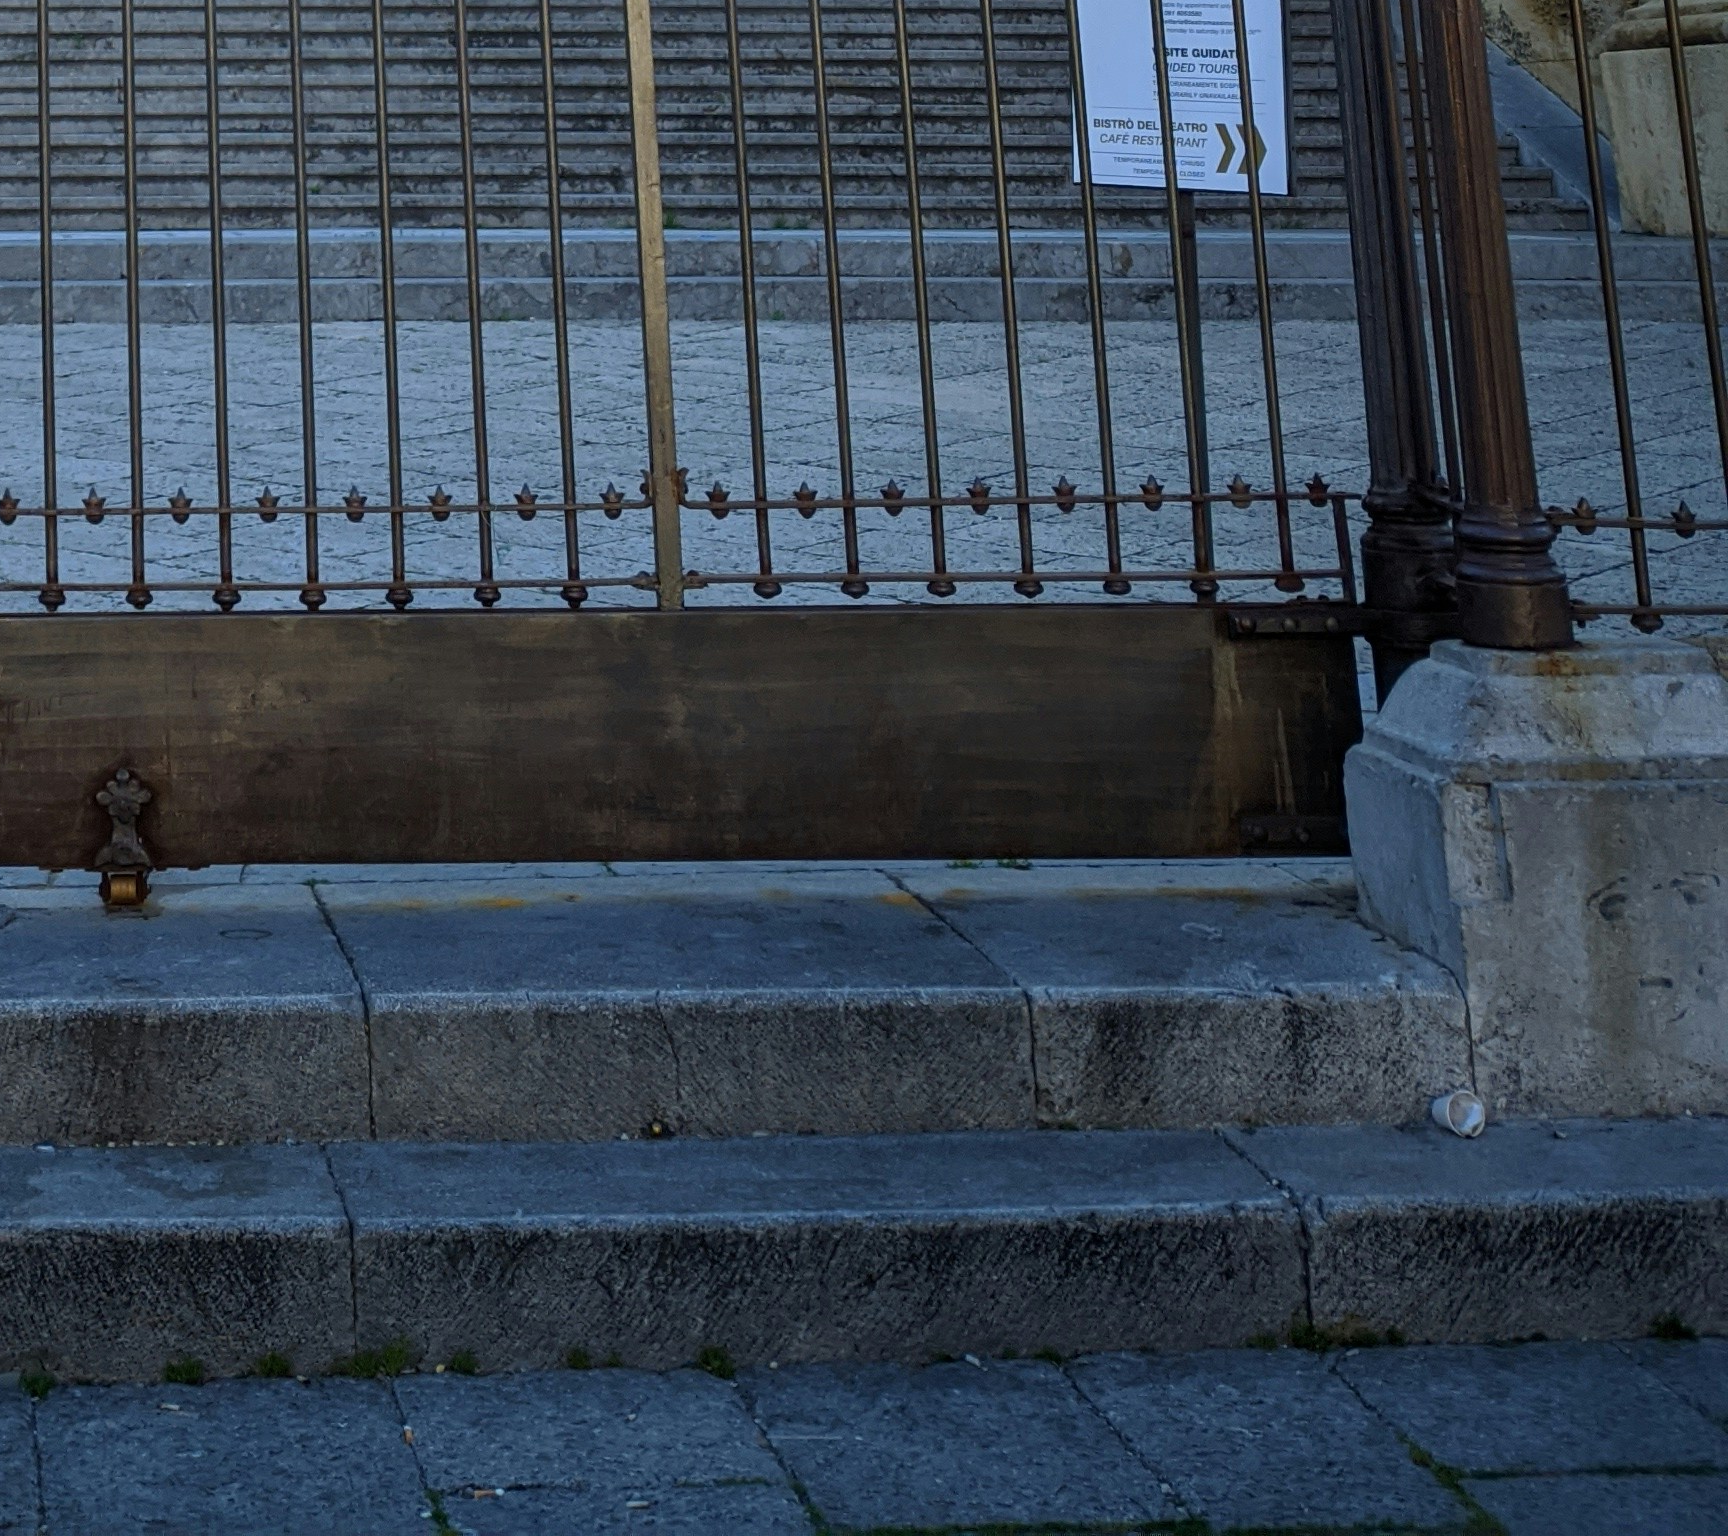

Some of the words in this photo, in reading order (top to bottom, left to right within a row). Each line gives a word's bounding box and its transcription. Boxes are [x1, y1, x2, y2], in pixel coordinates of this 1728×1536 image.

[1152, 47, 1188, 57] SITE
[1192, 48, 1237, 59] GUIDAT
[1152, 63, 1196, 73] IDED
[1199, 63, 1238, 74] TOURS
[1093, 117, 1134, 129] BISTRÒ
[1137, 121, 1160, 131] DEL
[1171, 122, 1208, 133] EATRO
[1132, 135, 1208, 148] RESTRANT
